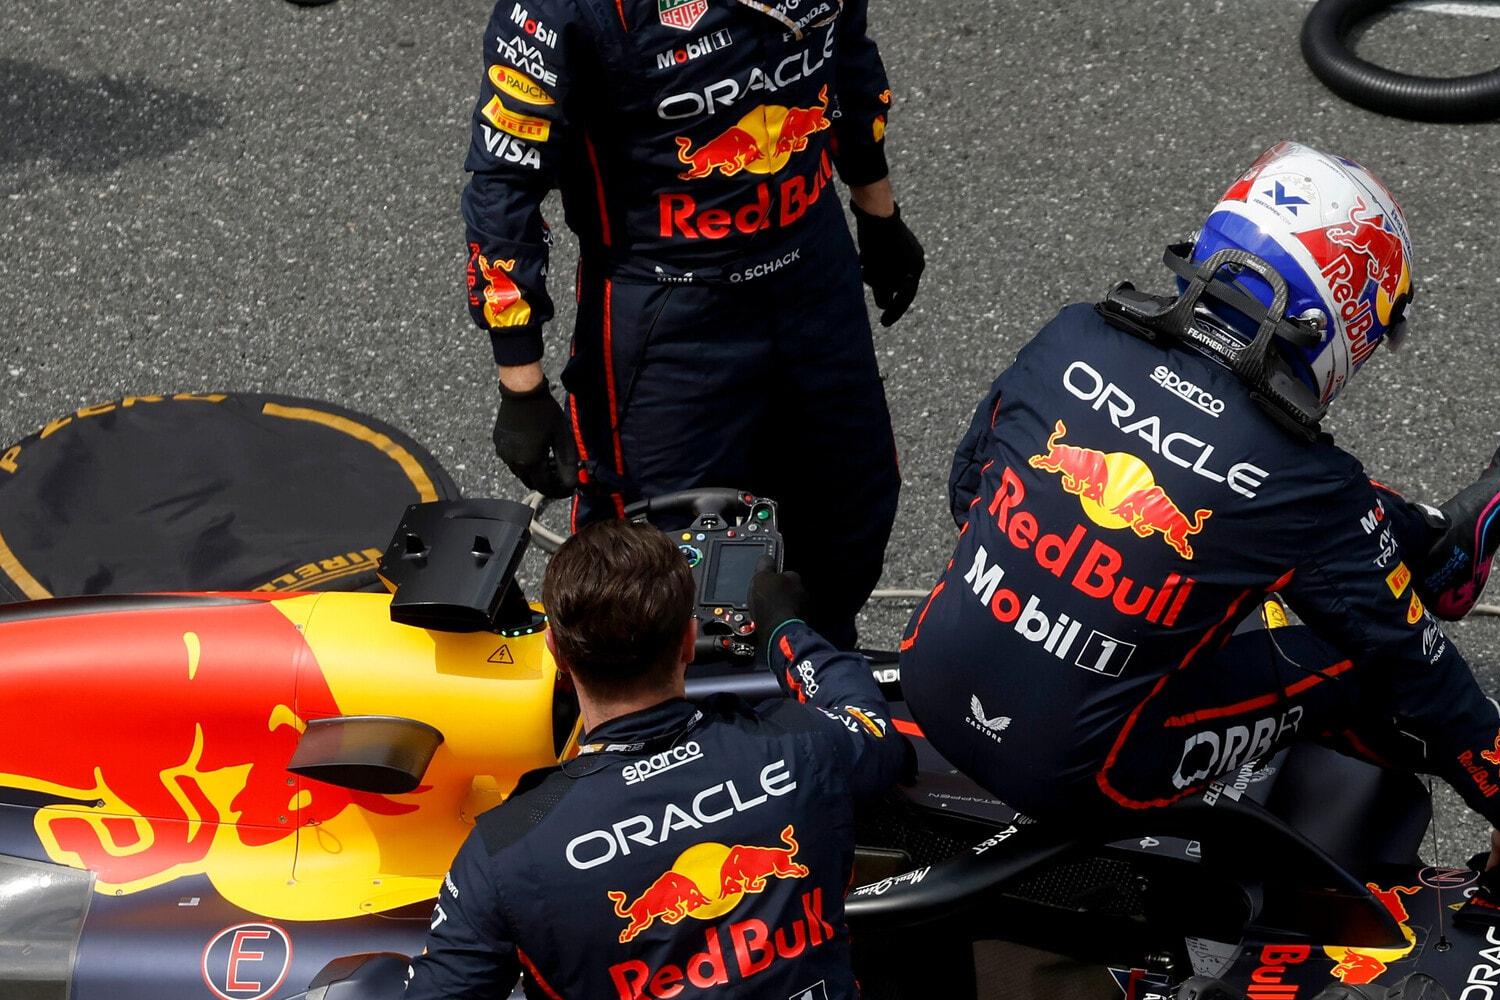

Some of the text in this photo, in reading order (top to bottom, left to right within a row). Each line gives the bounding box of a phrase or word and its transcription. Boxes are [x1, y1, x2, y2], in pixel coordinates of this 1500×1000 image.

[510, 3, 557, 48] Mobil
[662, 2, 708, 28] HEUER
[496, 36, 558, 87] TRADE
[657, 35, 712, 69] Mobil
[657, 21, 836, 120] ORACLE
[506, 75, 549, 100] RAUCH
[480, 124, 541, 169] VISA
[659, 182, 770, 239] Red
[1321, 253, 1377, 367] Red Bull
[1187, 327, 1238, 360] FEATHERLITE
[1149, 364, 1225, 417] sparco
[1063, 360, 1270, 498] ORACLE
[988, 466, 1196, 627] Red Bull
[964, 545, 1082, 660] Mobil
[965, 716, 1003, 743] CASTORE
[622, 741, 704, 786] sparco
[565, 760, 797, 870] ORACLE
[973, 824, 1018, 855] AT&T
[726, 888, 834, 978] Bull
[226, 930, 270, 992] E
